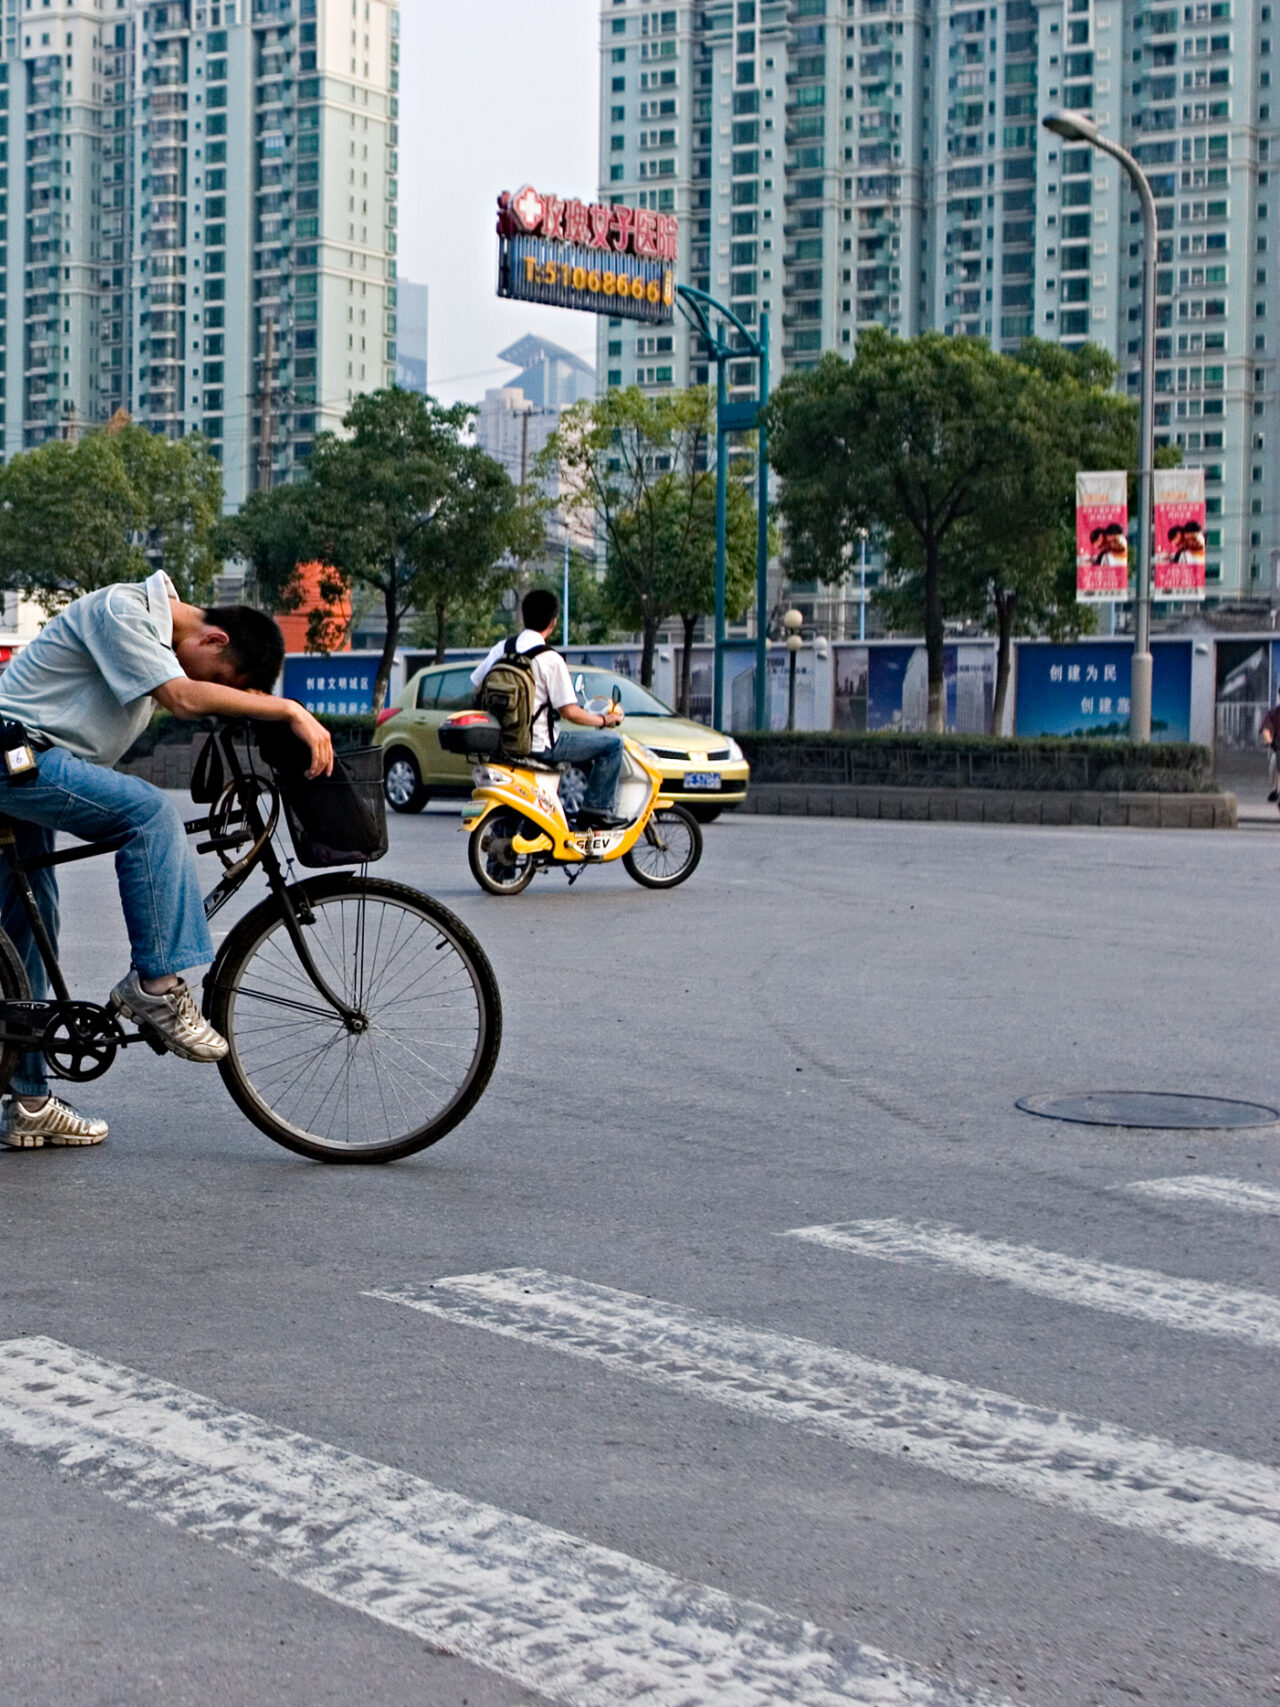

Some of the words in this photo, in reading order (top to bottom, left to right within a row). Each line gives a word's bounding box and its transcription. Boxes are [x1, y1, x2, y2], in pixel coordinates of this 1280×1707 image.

[541, 193, 679, 261] 玫瑰女子医院
[524, 255, 662, 305] T:51068666
[306, 676, 369, 690] 创建文明城区
[1050, 663, 1117, 682] 创建为民
